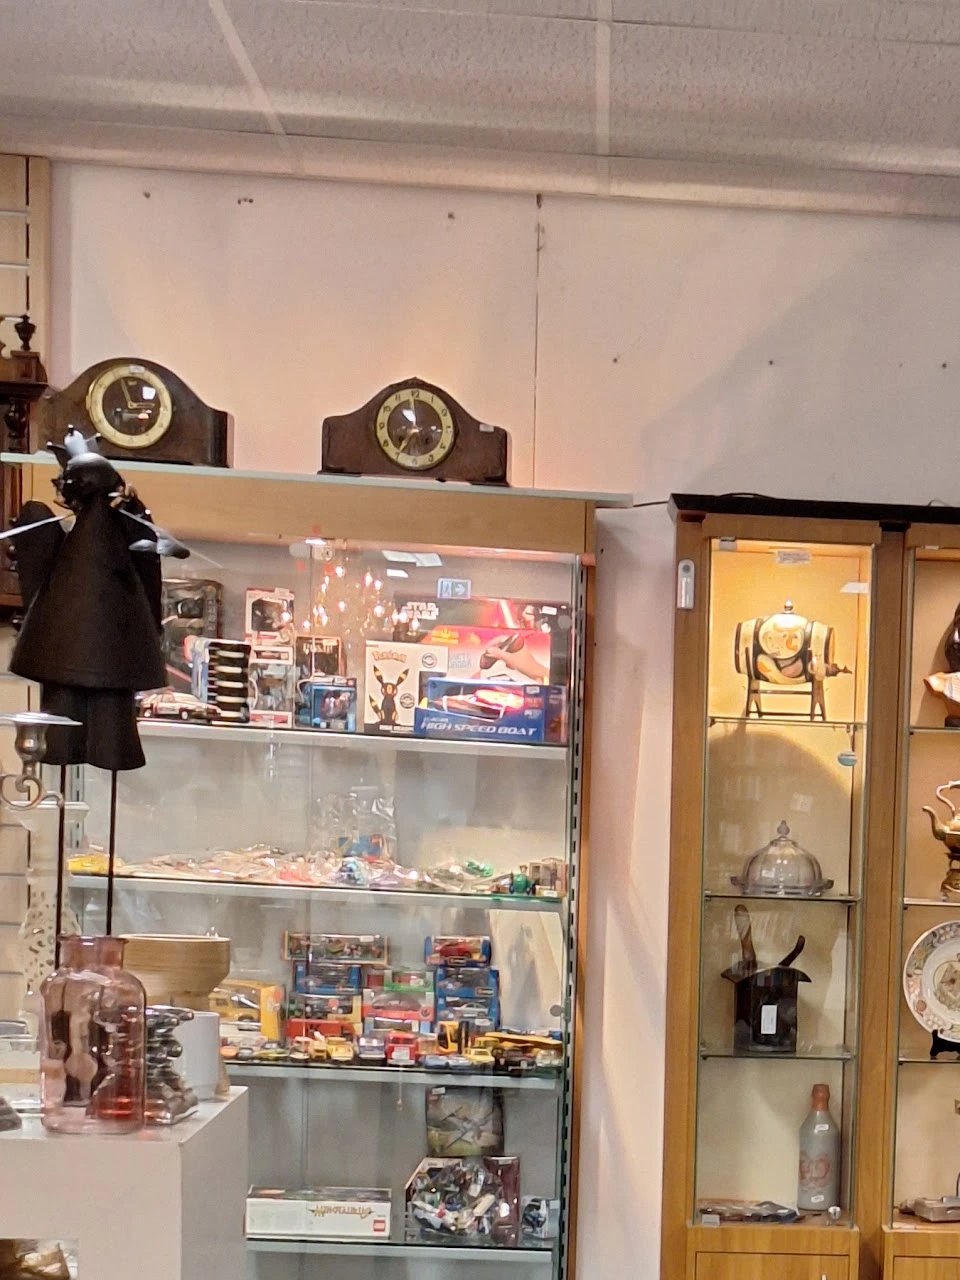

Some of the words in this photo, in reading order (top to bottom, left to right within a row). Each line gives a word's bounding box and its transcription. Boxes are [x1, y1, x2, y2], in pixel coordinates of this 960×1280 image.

[401, 601, 438, 611] STAR
[420, 721, 452, 730] HIGH
[454, 723, 497, 734] SPEED
[497, 726, 538, 736] BOAT
